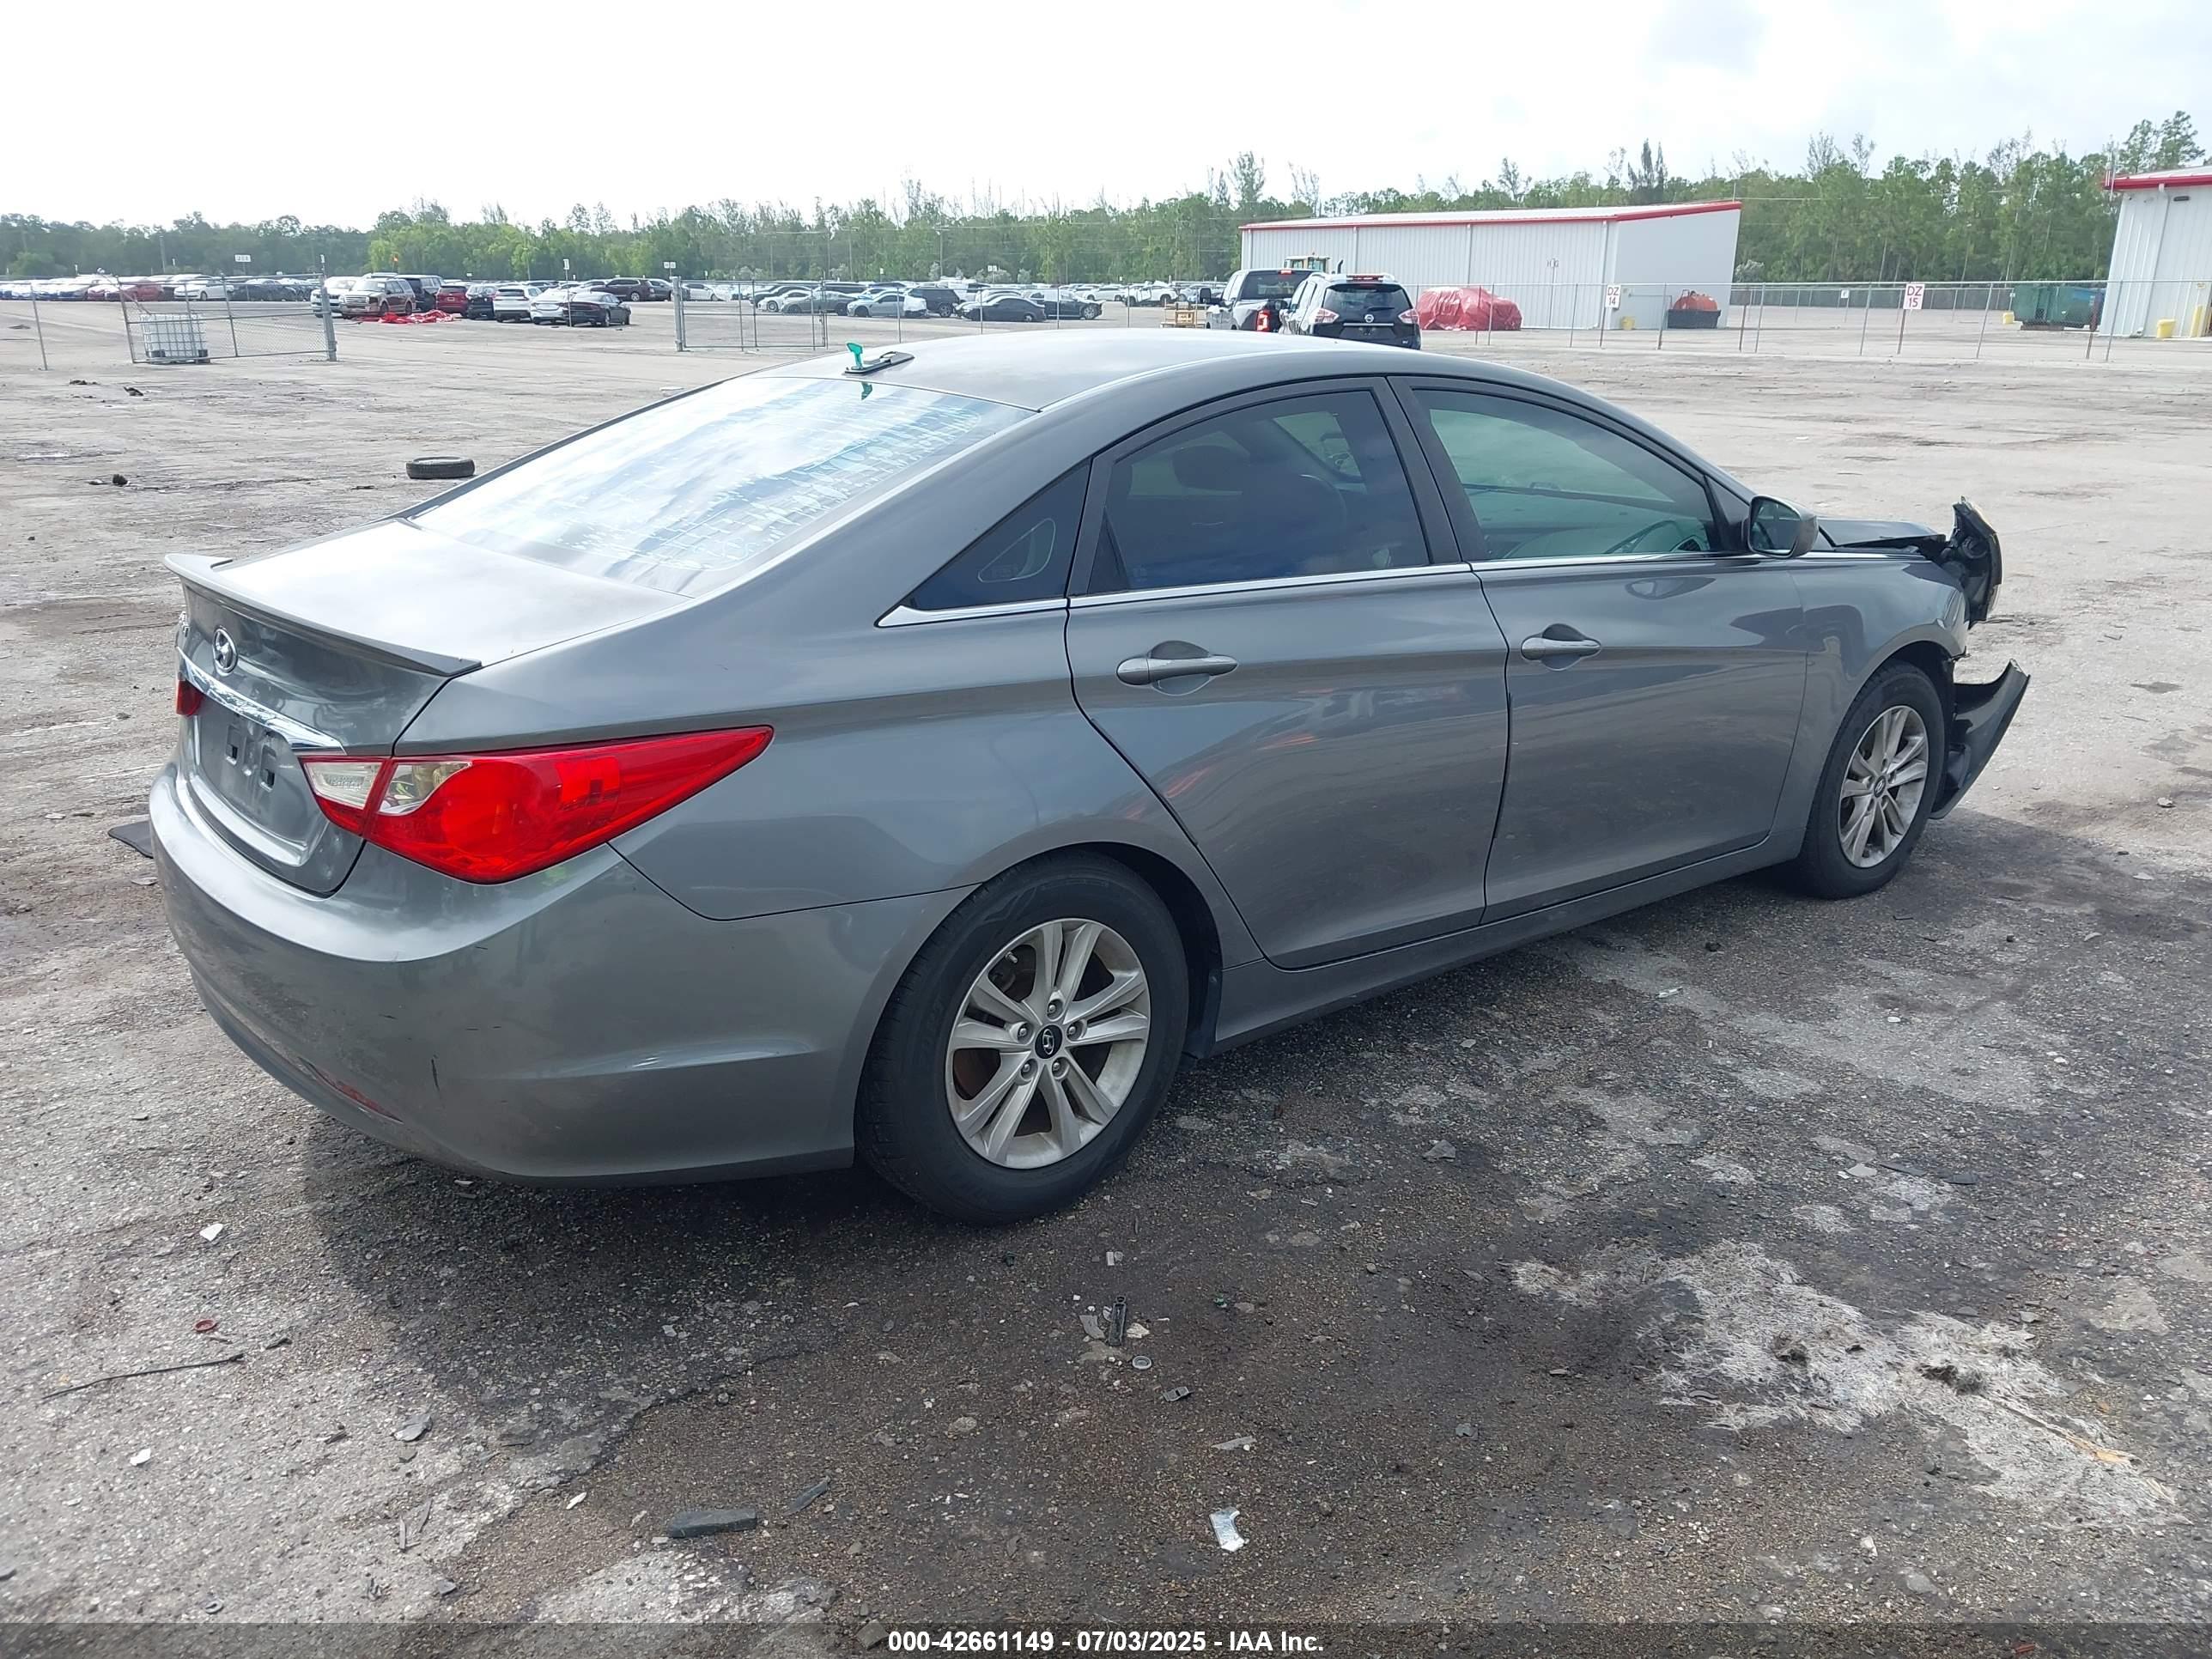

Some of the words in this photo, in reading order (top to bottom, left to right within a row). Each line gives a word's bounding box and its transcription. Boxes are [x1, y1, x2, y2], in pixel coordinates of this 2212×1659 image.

[1607, 287, 1620, 296] DZ
[1907, 286, 1923, 296] DZ
[1608, 296, 1616, 306] 14
[1909, 297, 1918, 307] 15
